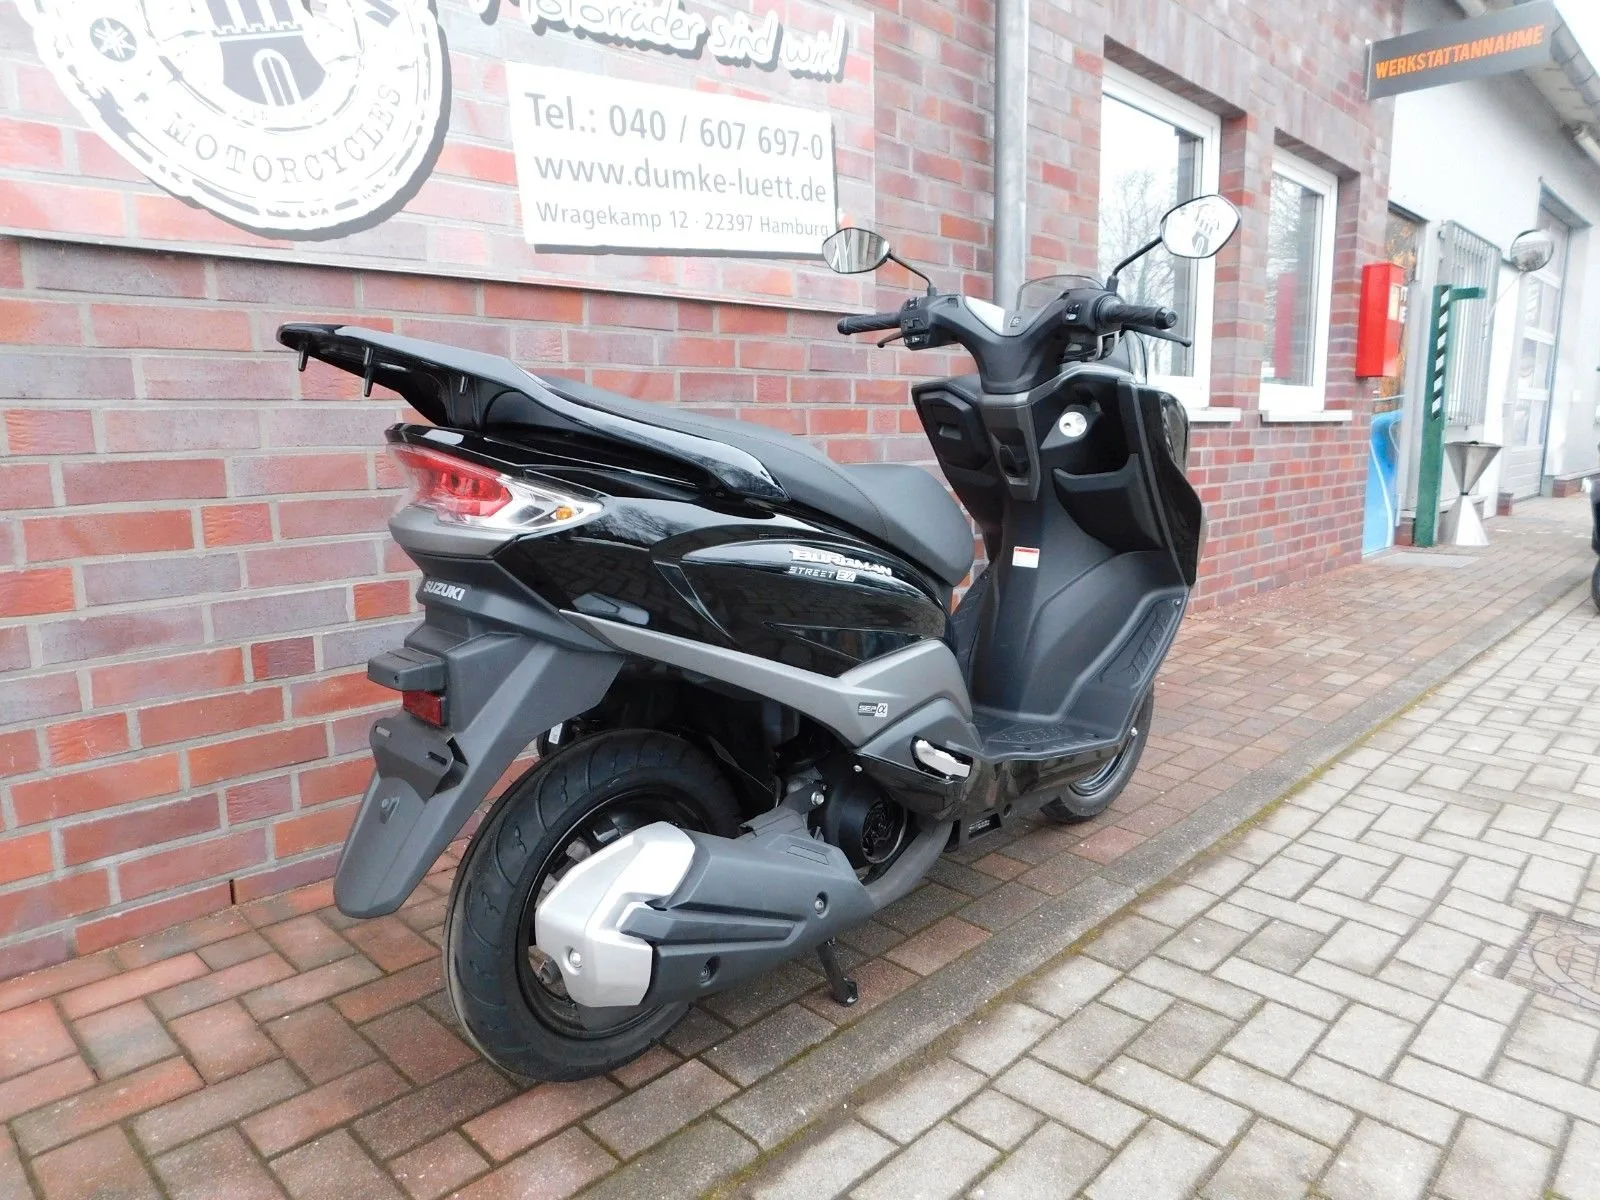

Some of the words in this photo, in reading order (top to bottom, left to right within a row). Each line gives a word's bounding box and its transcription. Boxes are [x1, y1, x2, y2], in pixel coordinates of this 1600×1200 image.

[714, 19, 774, 56] sind
[1375, 25, 1545, 79] WERKSTATTANNAHME
[162, 84, 401, 184] MOTORCYCLES
[525, 92, 596, 134] Tel.:
[609, 105, 667, 141] 040
[700, 118, 746, 150] 607
[758, 127, 823, 161] 697-0
[534, 155, 827, 203] www.dumke-luett.de
[536, 201, 662, 233] Wragekamp
[670, 211, 689, 230] 12
[705, 213, 753, 232] 22397
[760, 215, 829, 237] Hamburg
[788, 566, 835, 578] STREET
[789, 548, 892, 577] BURGMAN
[424, 580, 465, 601] SUZUKI
